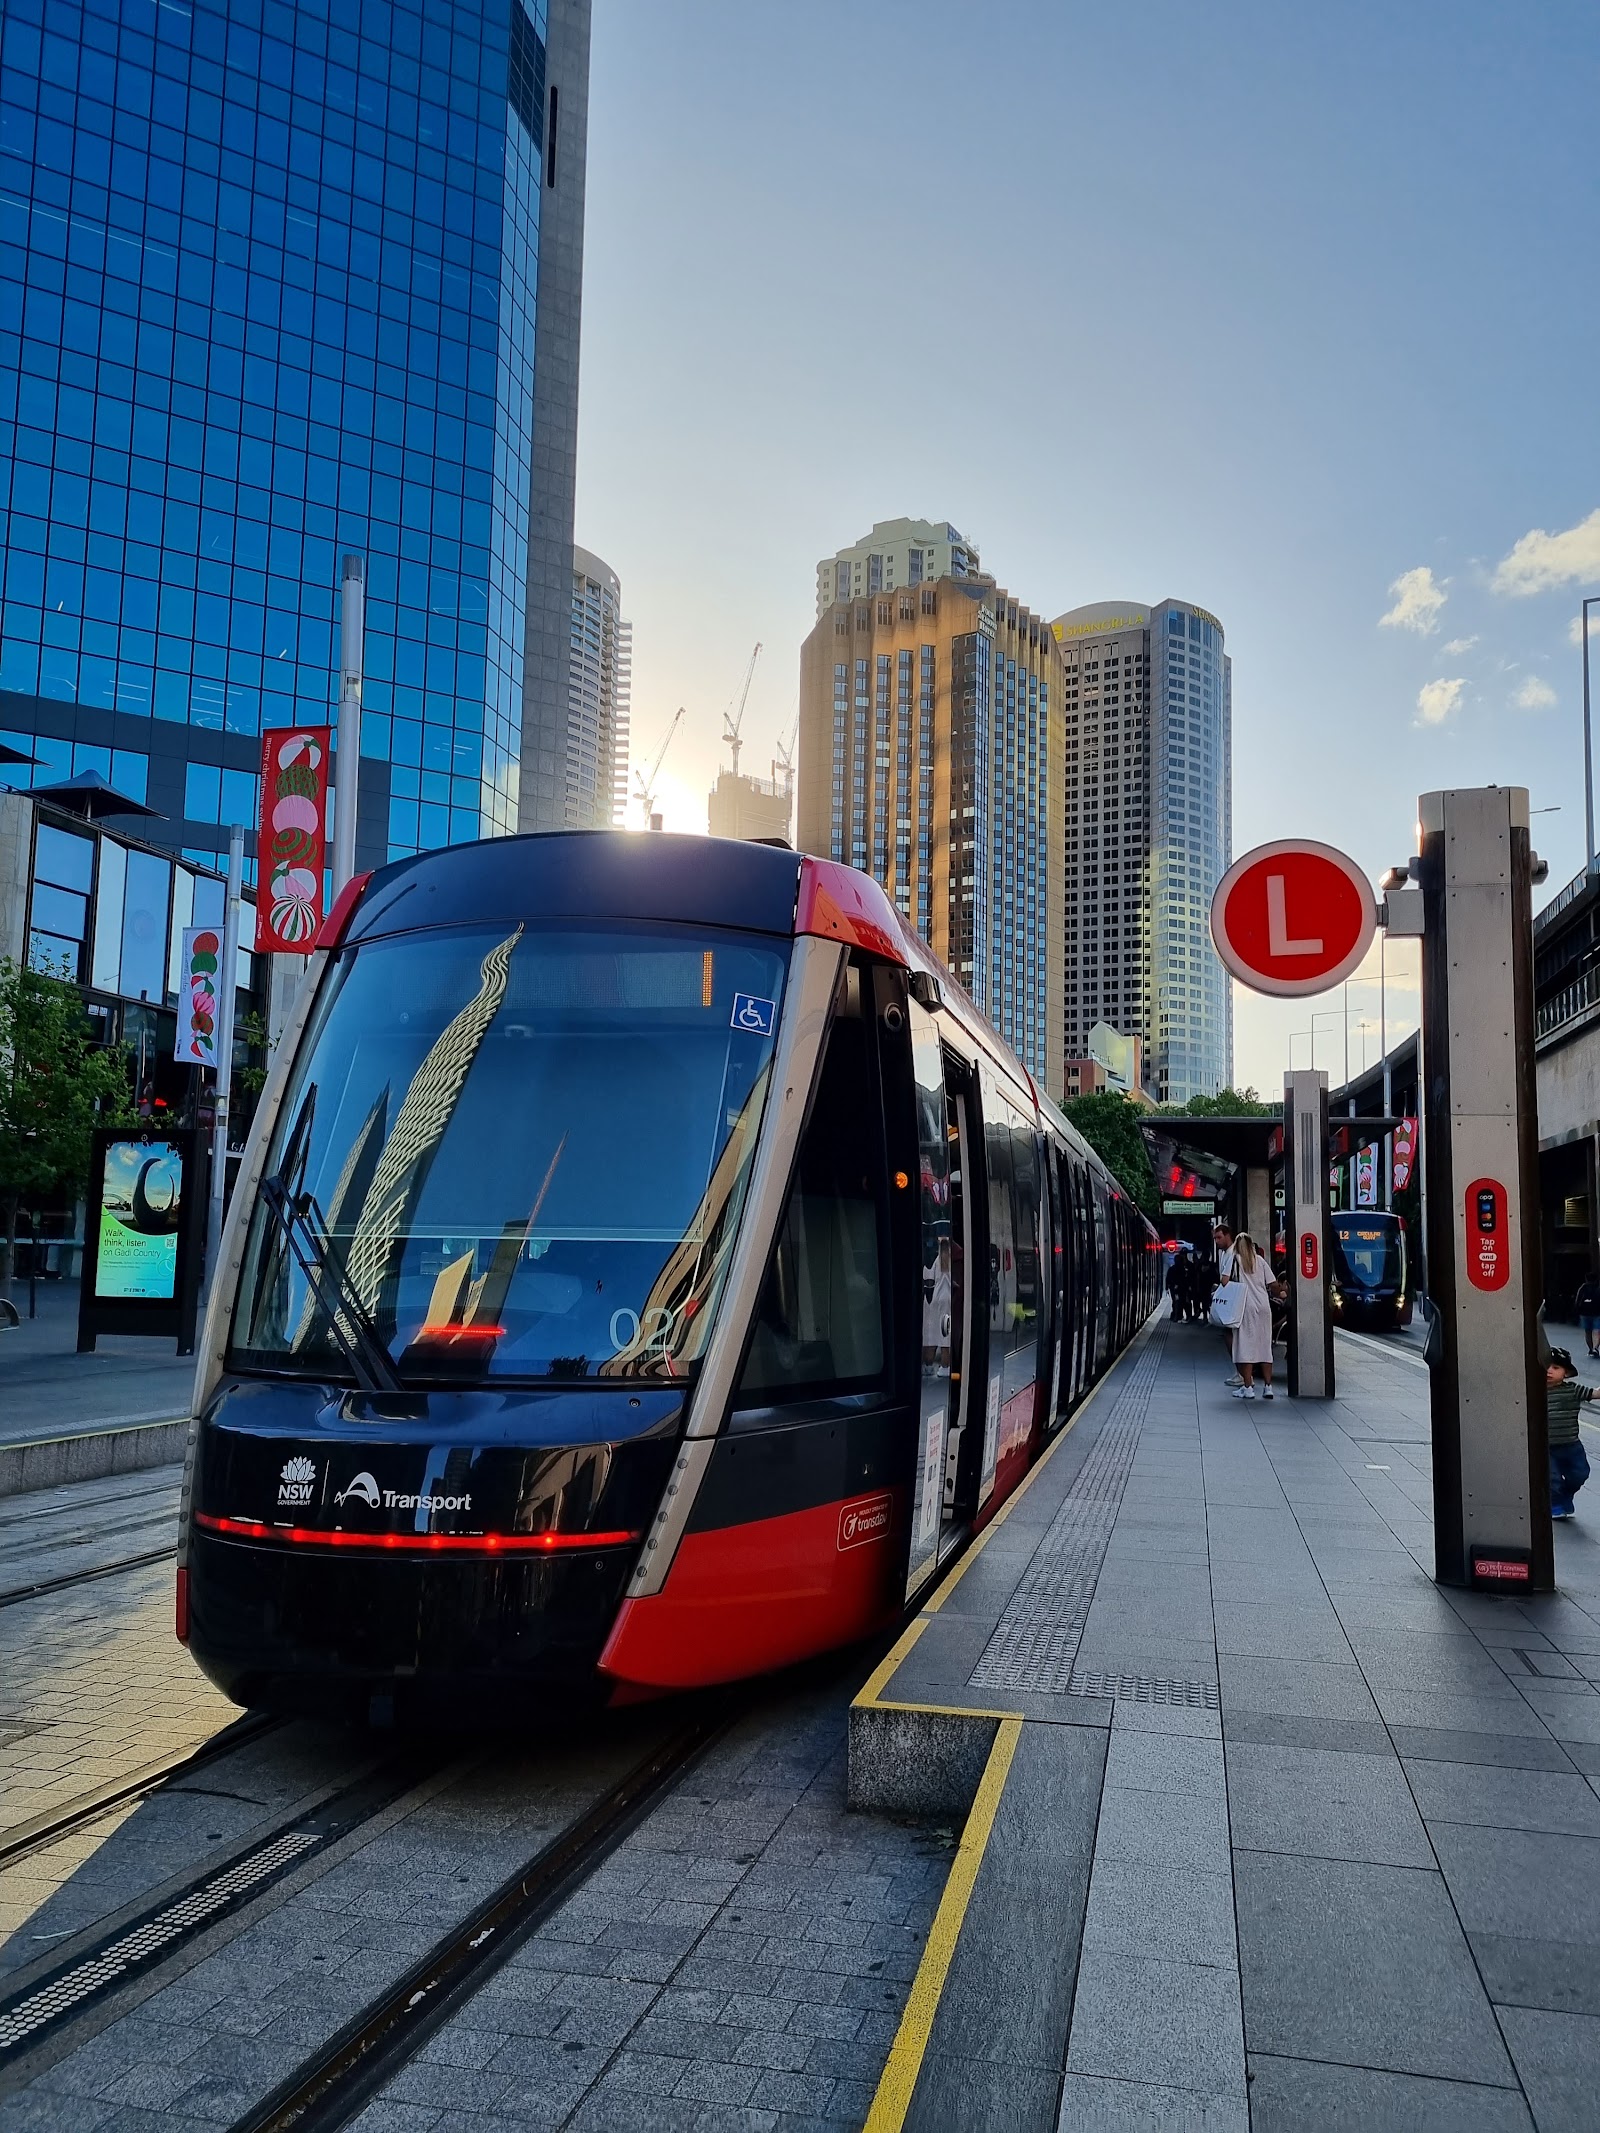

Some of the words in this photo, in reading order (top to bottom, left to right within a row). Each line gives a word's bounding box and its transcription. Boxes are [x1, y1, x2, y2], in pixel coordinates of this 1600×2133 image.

[263, 737, 272, 762] merry
[259, 763, 269, 805] christmas
[1267, 875, 1323, 956] L
[105, 1229, 126, 1237] Walk,
[1340, 1231, 1349, 1240] L2
[104, 1239, 125, 1247] think,
[1480, 1238, 1495, 1246] Tap
[133, 1249, 161, 1259] Country
[609, 1307, 675, 1352] 02
[278, 1484, 314, 1499] NSW
[383, 1489, 472, 1513] Transport
[858, 1512, 888, 1531] transdev
